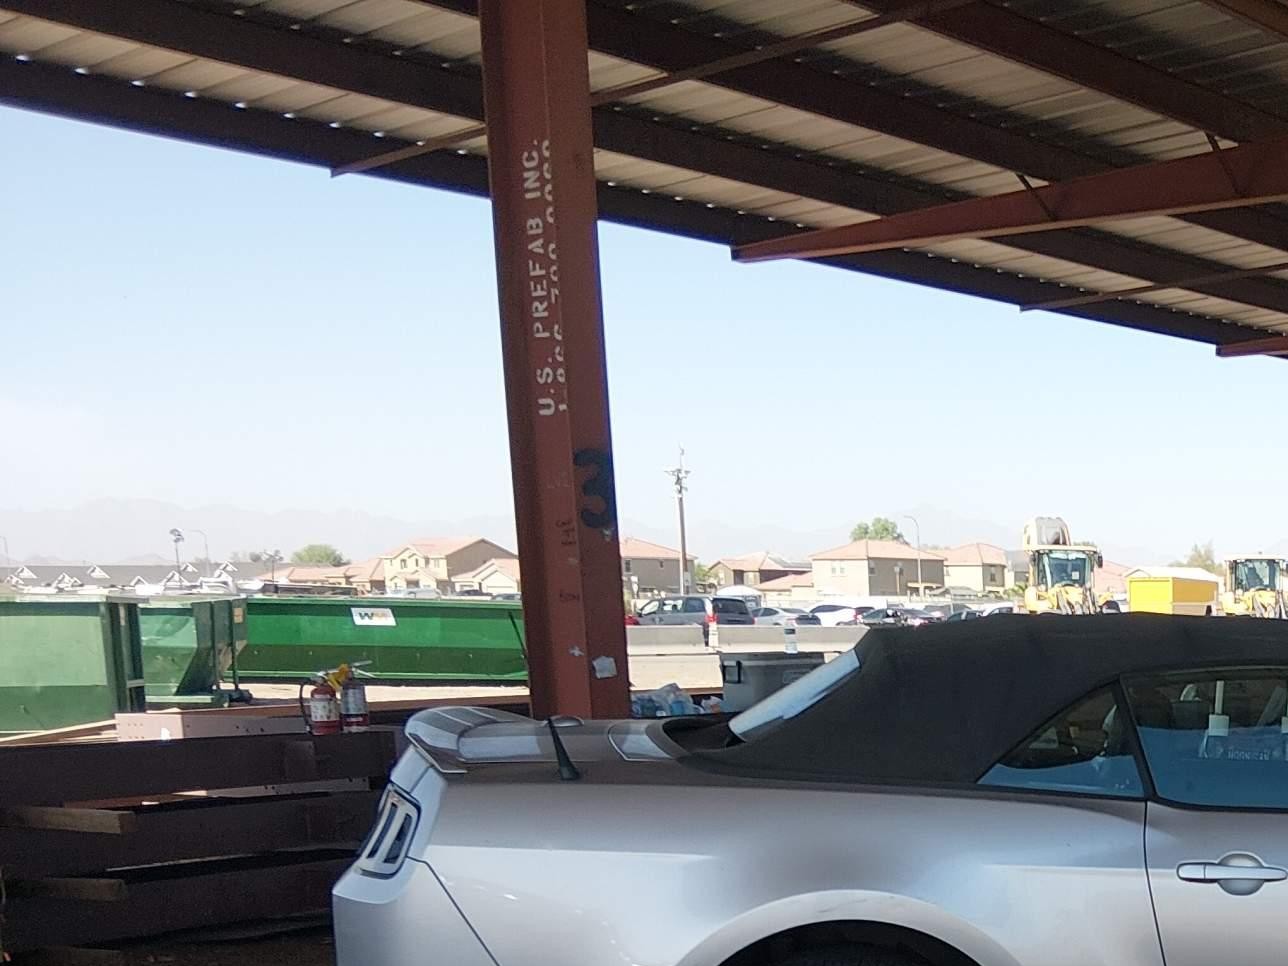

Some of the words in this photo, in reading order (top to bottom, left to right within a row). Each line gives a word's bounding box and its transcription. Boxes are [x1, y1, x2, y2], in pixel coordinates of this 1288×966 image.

[522, 139, 542, 199] INC.
[526, 217, 551, 338] PREFAB
[536, 356, 556, 416] U.S.
[573, 448, 614, 528] 3
